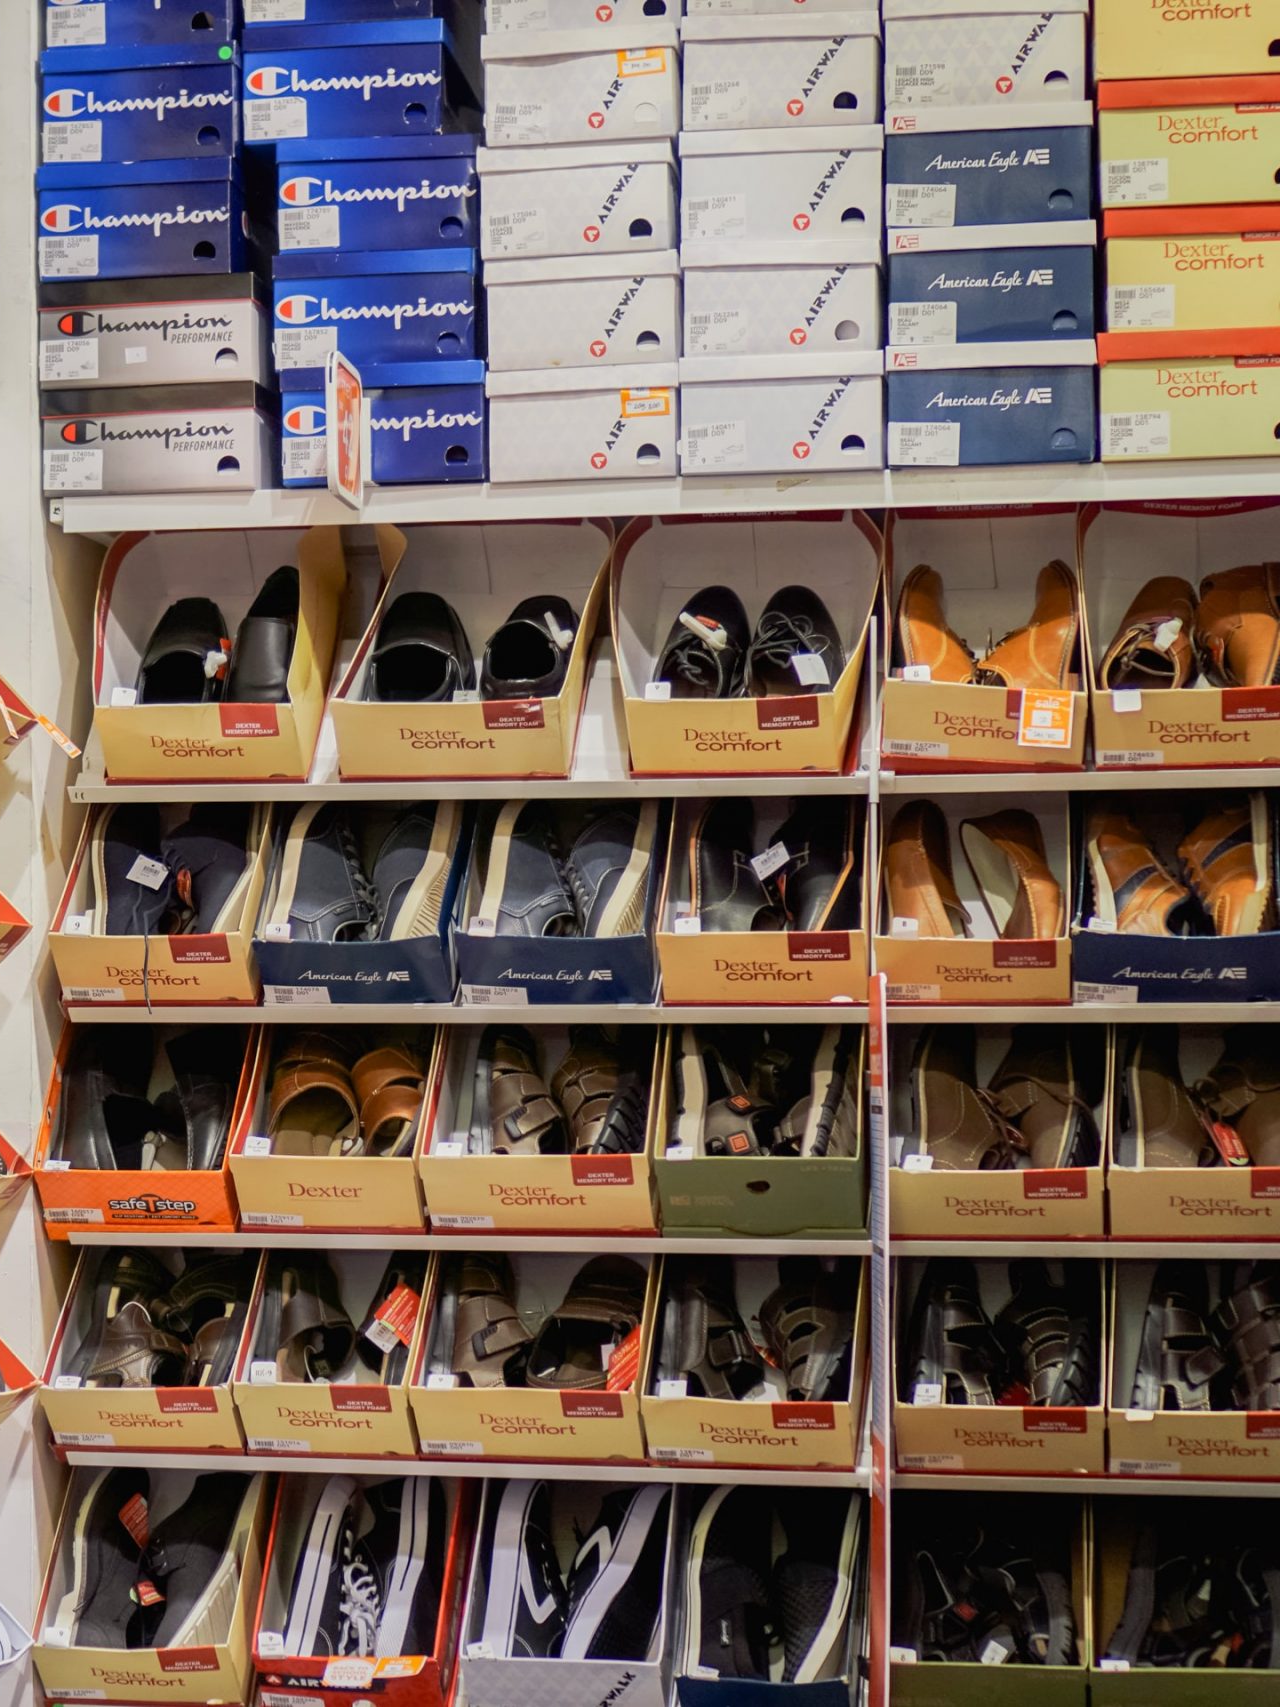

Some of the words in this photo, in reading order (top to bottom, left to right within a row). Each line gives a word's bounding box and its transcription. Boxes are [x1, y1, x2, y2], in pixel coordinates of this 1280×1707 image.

[1162, 4, 1252, 21] comfort
[246, 67, 441, 101] Champion
[44, 88, 234, 121] Champion
[1158, 115, 1223, 131] Dexter
[1168, 126, 1258, 144] comfort
[925, 154, 986, 171] American
[988, 150, 1019, 173] Eagle
[279, 176, 477, 212] Champion
[40, 204, 230, 237] Champion
[1164, 242, 1230, 258] Dexter
[1175, 254, 1265, 271] comfort
[928, 273, 988, 290] American
[991, 270, 1022, 292] Eagle
[275, 294, 475, 330] Champion
[57, 311, 233, 341] Champion
[171, 331, 232, 344] PERFORMANCE
[1156, 369, 1222, 385] Dexter
[1167, 380, 1258, 398] comfort
[926, 391, 987, 408] American
[990, 389, 1022, 411] Eagle
[61, 420, 234, 449] Champion
[173, 439, 234, 452] PERFORMANCE
[1035, 697, 1060, 709] sale
[933, 711, 1000, 726] Dexter
[1148, 720, 1215, 734] Dexter
[399, 728, 463, 740] Dexter
[683, 728, 749, 742] Dexter
[1160, 730, 1251, 744] comfort
[150, 735, 211, 748] Dexter
[411, 737, 496, 750] comfort
[695, 738, 782, 752] comfort
[162, 746, 245, 758] comfort
[75, 921, 80, 929] 9
[713, 959, 780, 972] Dexter
[935, 965, 986, 975] Dexter
[298, 969, 353, 981] American
[355, 971, 382, 984] Eagle
[497, 968, 553, 980] American
[555, 970, 584, 984] Eagle
[726, 970, 813, 982] comfort
[944, 974, 1013, 982] comfort
[1113, 966, 1178, 979] American
[1180, 968, 1214, 982] Eagle
[287, 1182, 362, 1198] Dexter
[488, 1184, 551, 1196] Dexter
[501, 1194, 587, 1206] comfort
[944, 1196, 1008, 1208] Dexter
[1169, 1196, 1237, 1208] Dexter
[956, 1206, 1046, 1216] comfort
[1180, 1206, 1272, 1216] comfort
[98, 1410, 153, 1420] Dexter
[277, 1406, 337, 1420] Dexter
[478, 1413, 541, 1426] Dexter
[110, 1419, 183, 1428] comfort
[289, 1418, 373, 1429] comfort
[491, 1424, 576, 1436] comfort
[699, 1422, 764, 1436] Dexter
[711, 1434, 799, 1446] comfort
[953, 1428, 1010, 1439] Dexter
[963, 1438, 1045, 1448] comfort
[1168, 1436, 1231, 1448] Dexter
[1177, 1446, 1270, 1457] comfort
[91, 1667, 150, 1679] Dexter
[103, 1677, 186, 1687] comfort
